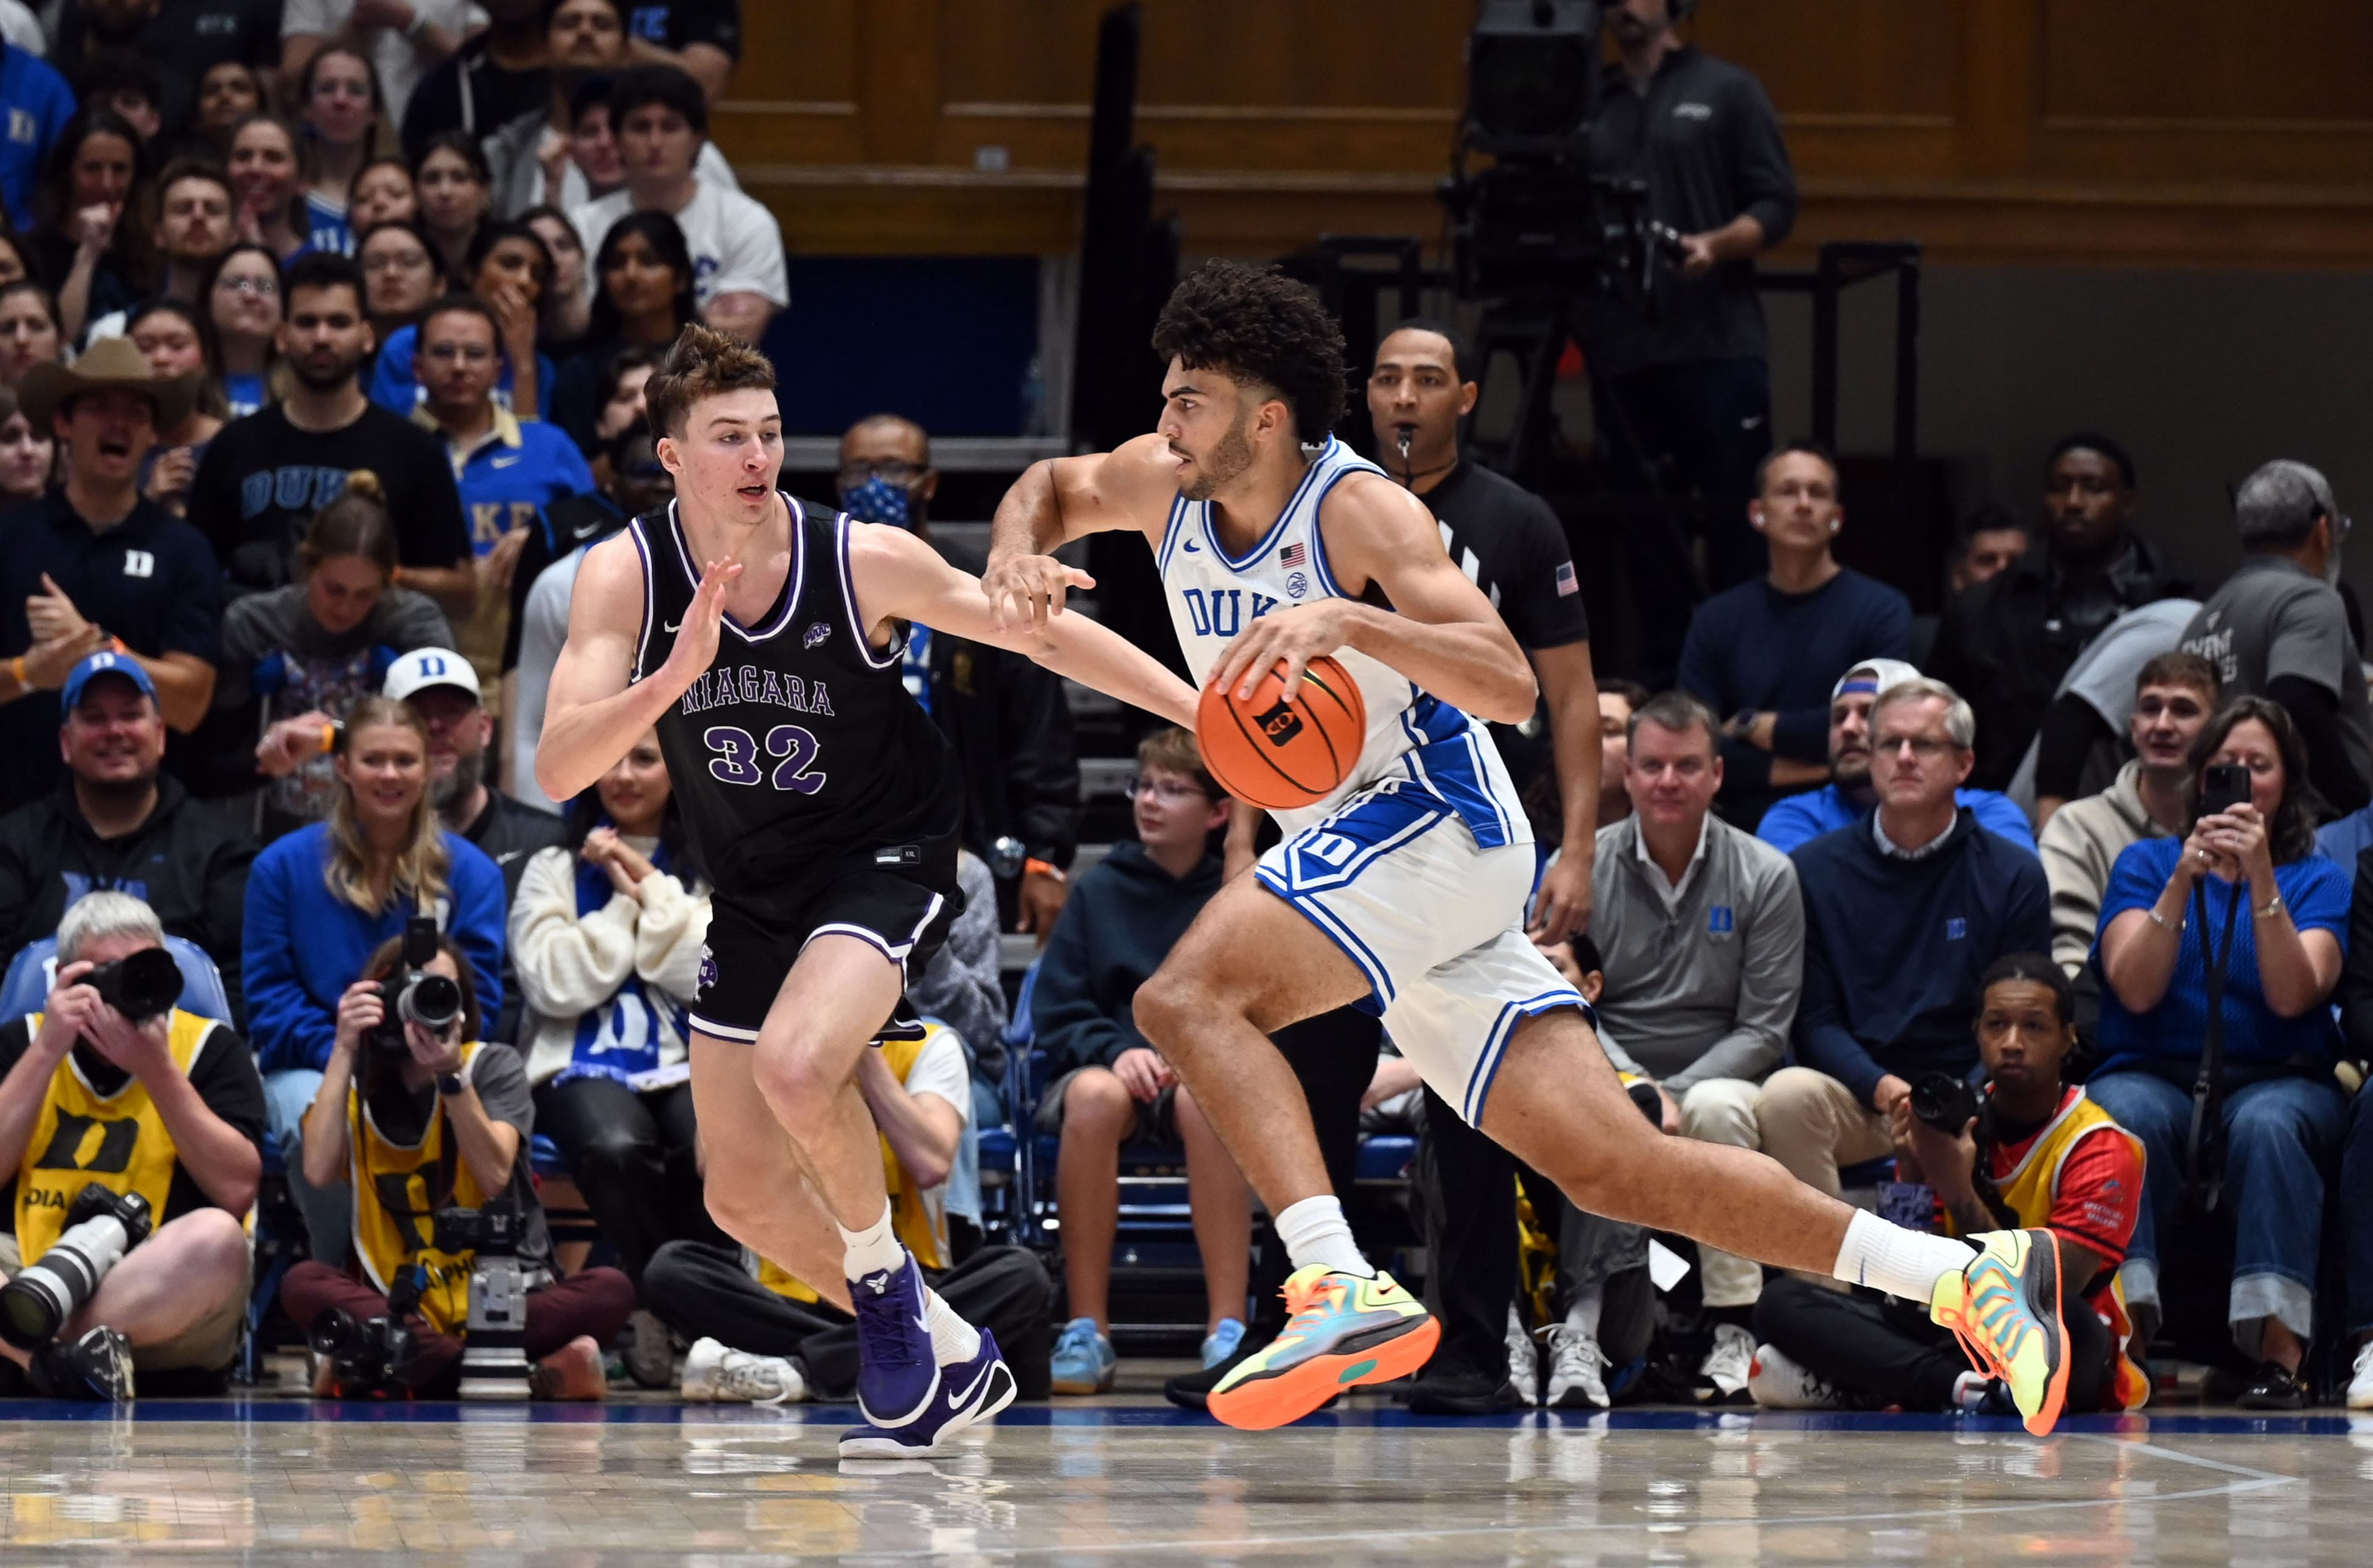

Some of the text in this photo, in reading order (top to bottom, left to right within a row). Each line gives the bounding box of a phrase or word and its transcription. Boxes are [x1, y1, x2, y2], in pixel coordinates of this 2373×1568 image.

[242, 465, 347, 520] DUK
[124, 549, 154, 577] D
[1183, 588, 1279, 636] DUK
[420, 657, 446, 677] D
[682, 665, 835, 716] NIAGARA
[704, 725, 826, 795] 32
[1302, 832, 1357, 867] D
[33, 1103, 139, 1173] D
